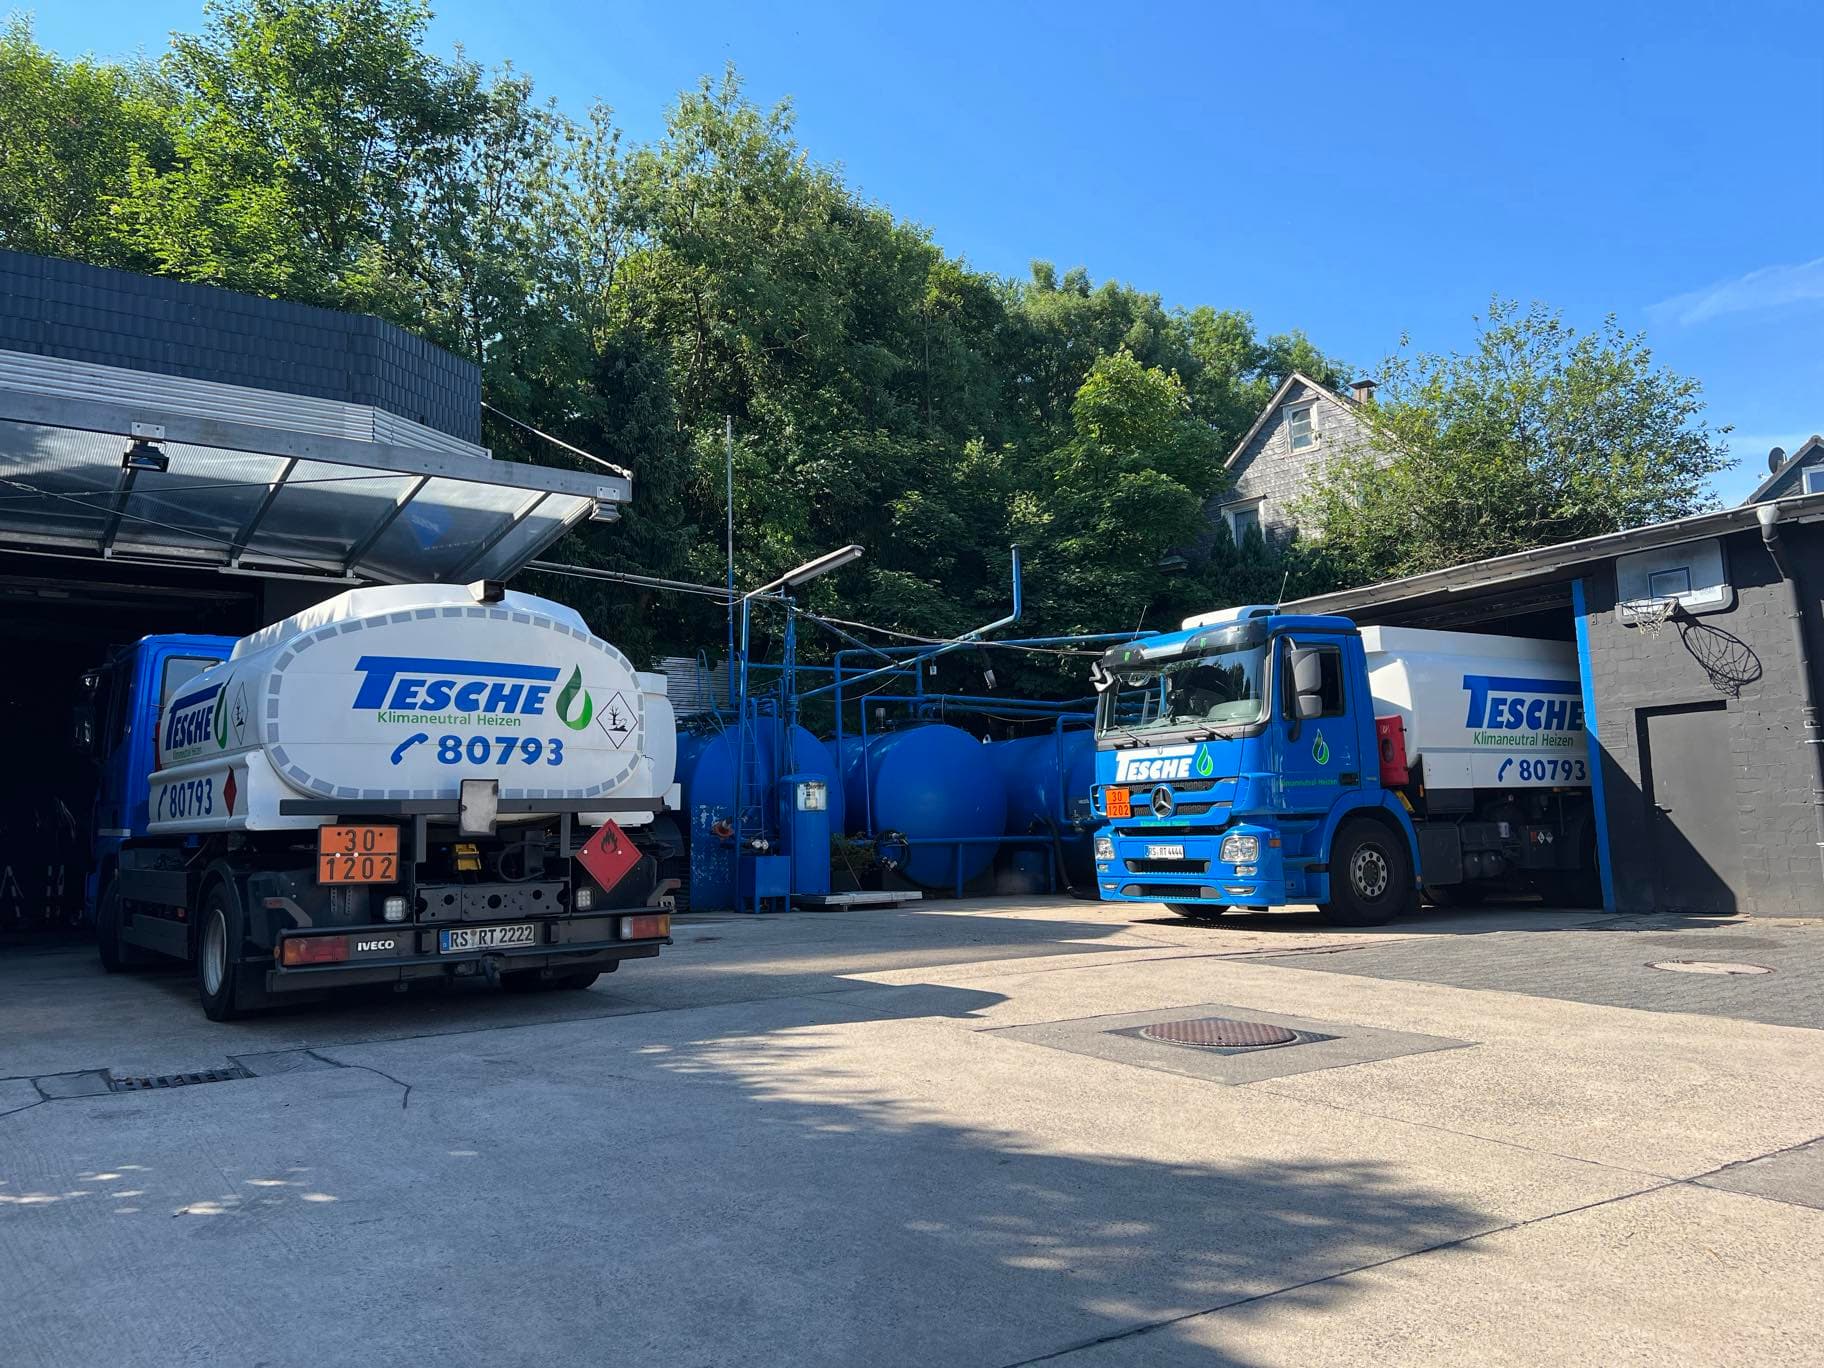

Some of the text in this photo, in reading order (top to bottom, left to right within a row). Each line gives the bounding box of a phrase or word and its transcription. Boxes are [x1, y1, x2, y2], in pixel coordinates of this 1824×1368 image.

[352, 655, 561, 715] TESCHE
[1463, 675, 1583, 731] TESCHE
[165, 682, 224, 751] TESCHE
[377, 711, 521, 727] Klimaneutral Heizen
[437, 734, 564, 766] 80793
[1473, 731, 1574, 747] Klimaneutral Heizen
[1116, 744, 1198, 781] TESCHE
[1519, 759, 1586, 781] 80793
[169, 778, 213, 818] 80793
[1111, 791, 1123, 802] 30
[1108, 804, 1129, 816] 1202
[344, 829, 375, 852] 30
[326, 857, 393, 880] 1202
[357, 940, 395, 951] IVECO
[450, 931, 468, 948] RS
[479, 929, 496, 945] RT
[499, 926, 533, 944] 2222
